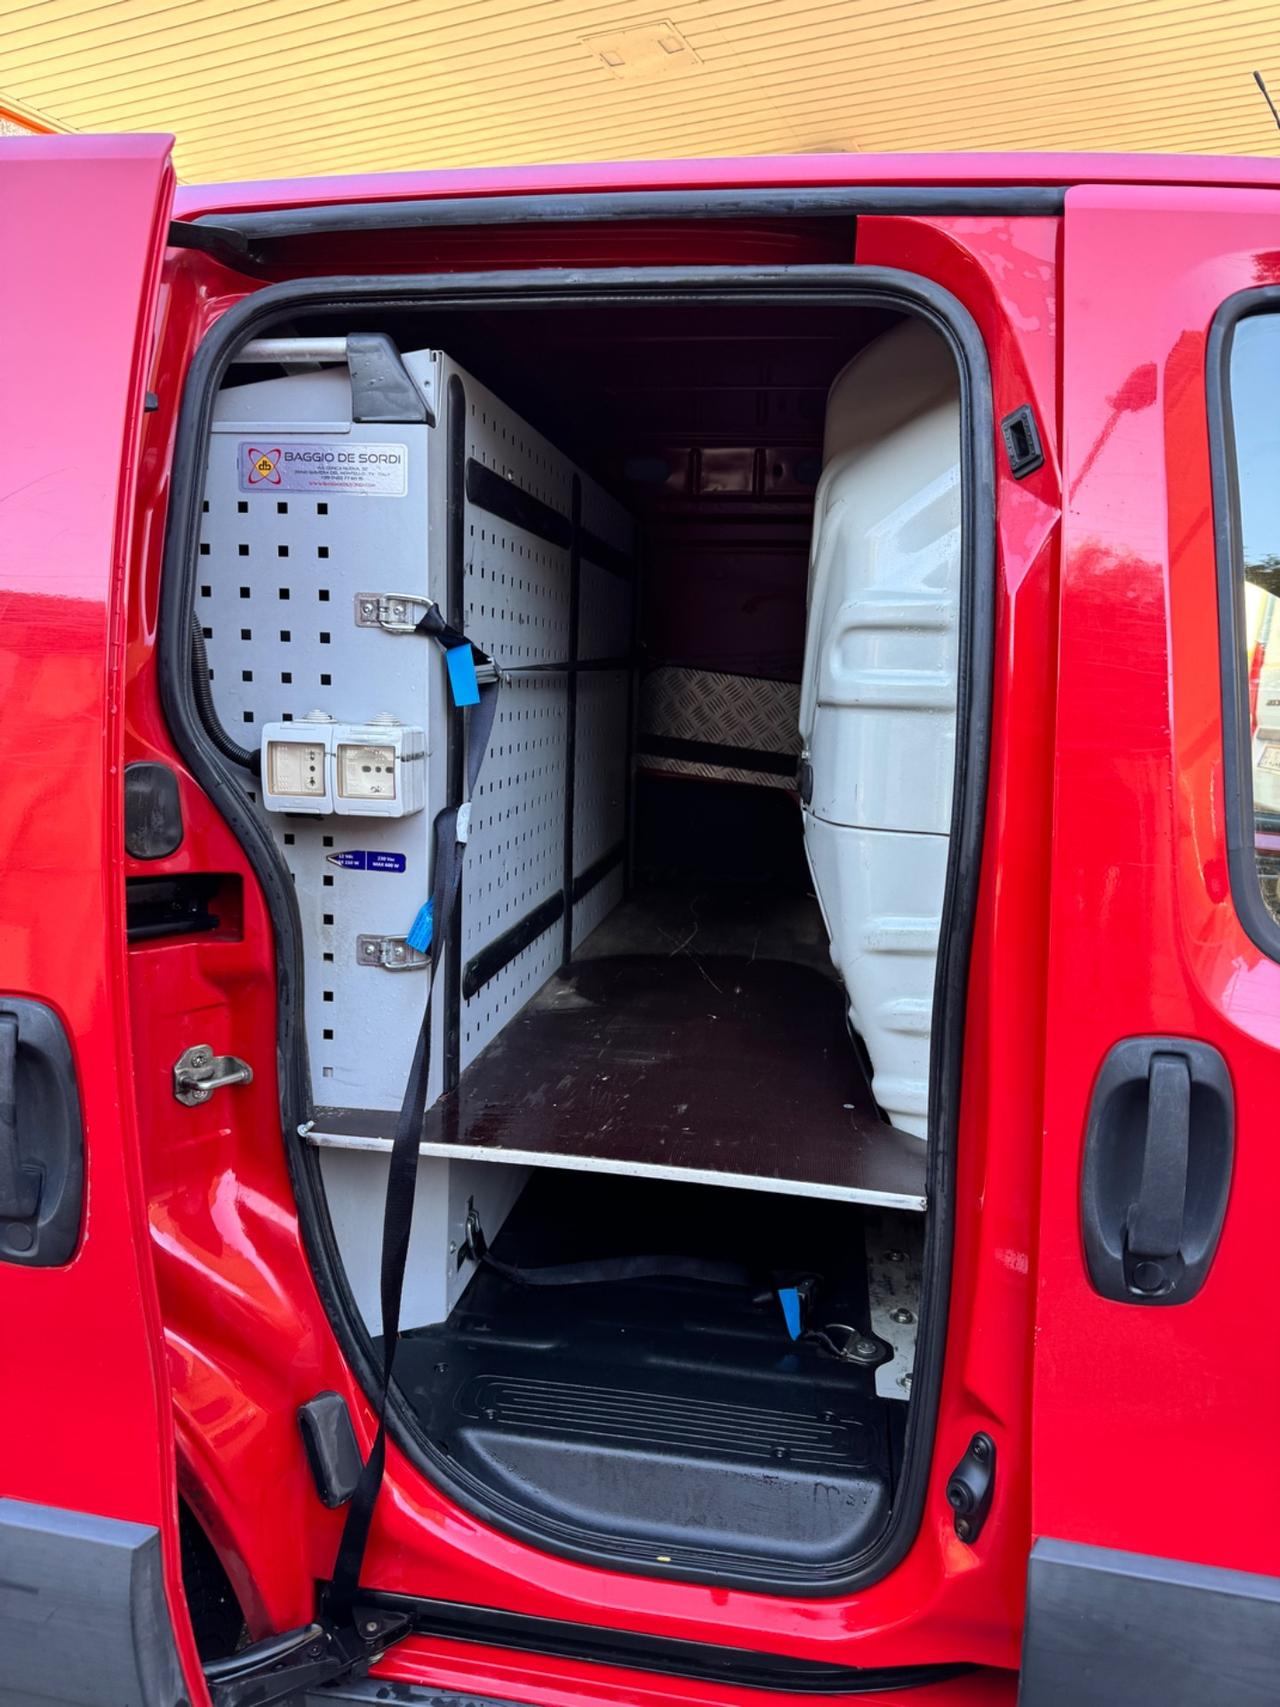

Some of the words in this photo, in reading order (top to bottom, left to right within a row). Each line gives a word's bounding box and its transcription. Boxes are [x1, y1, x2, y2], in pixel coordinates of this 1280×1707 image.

[284, 452, 335, 462] BAGGIO
[337, 453, 356, 463] DE
[358, 454, 401, 464] SORDI
